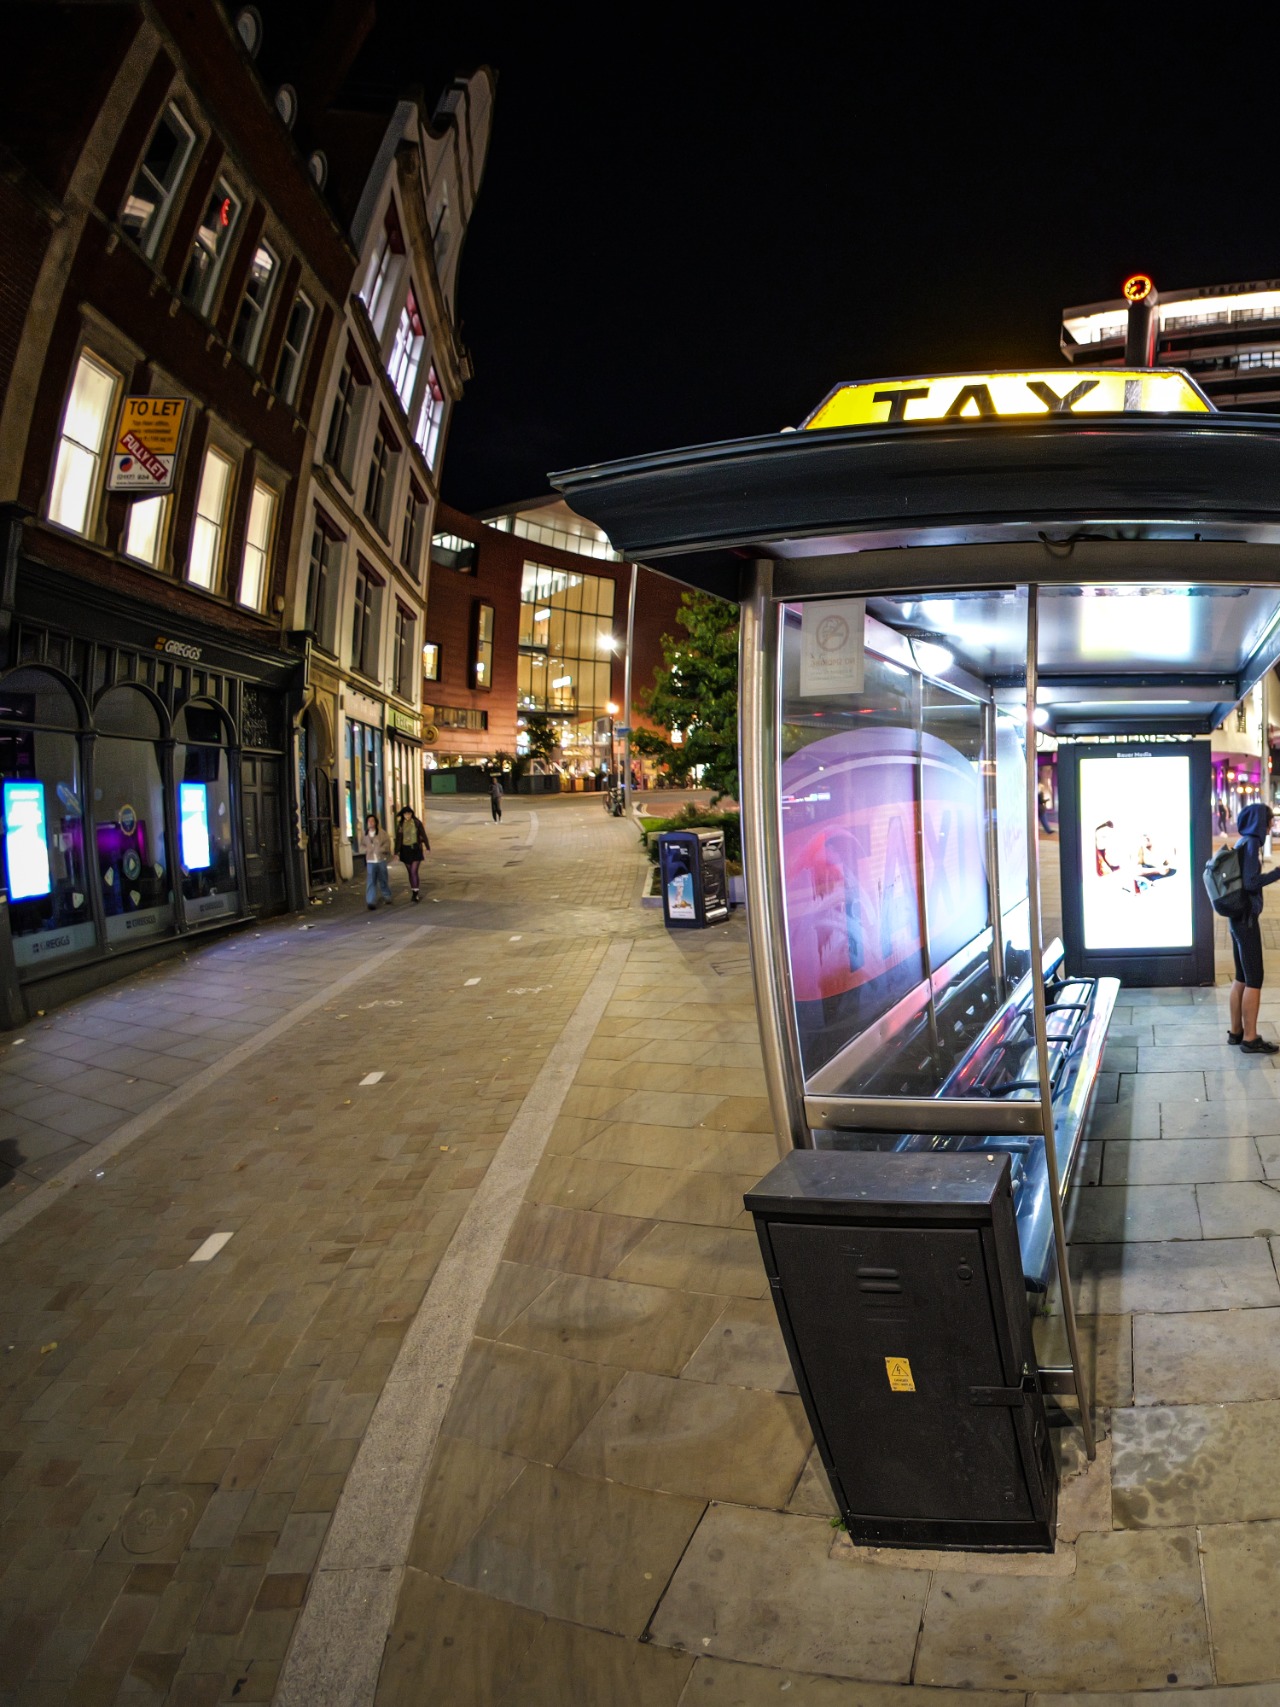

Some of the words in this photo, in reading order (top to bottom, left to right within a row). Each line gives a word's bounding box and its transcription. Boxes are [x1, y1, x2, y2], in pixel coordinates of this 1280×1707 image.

[129, 401, 149, 416] TO
[152, 401, 181, 416] LET
[122, 433, 150, 462] FULLY
[145, 458, 165, 477] LET
[165, 640, 202, 660] GREGGS
[824, 808, 968, 974] TAXI
